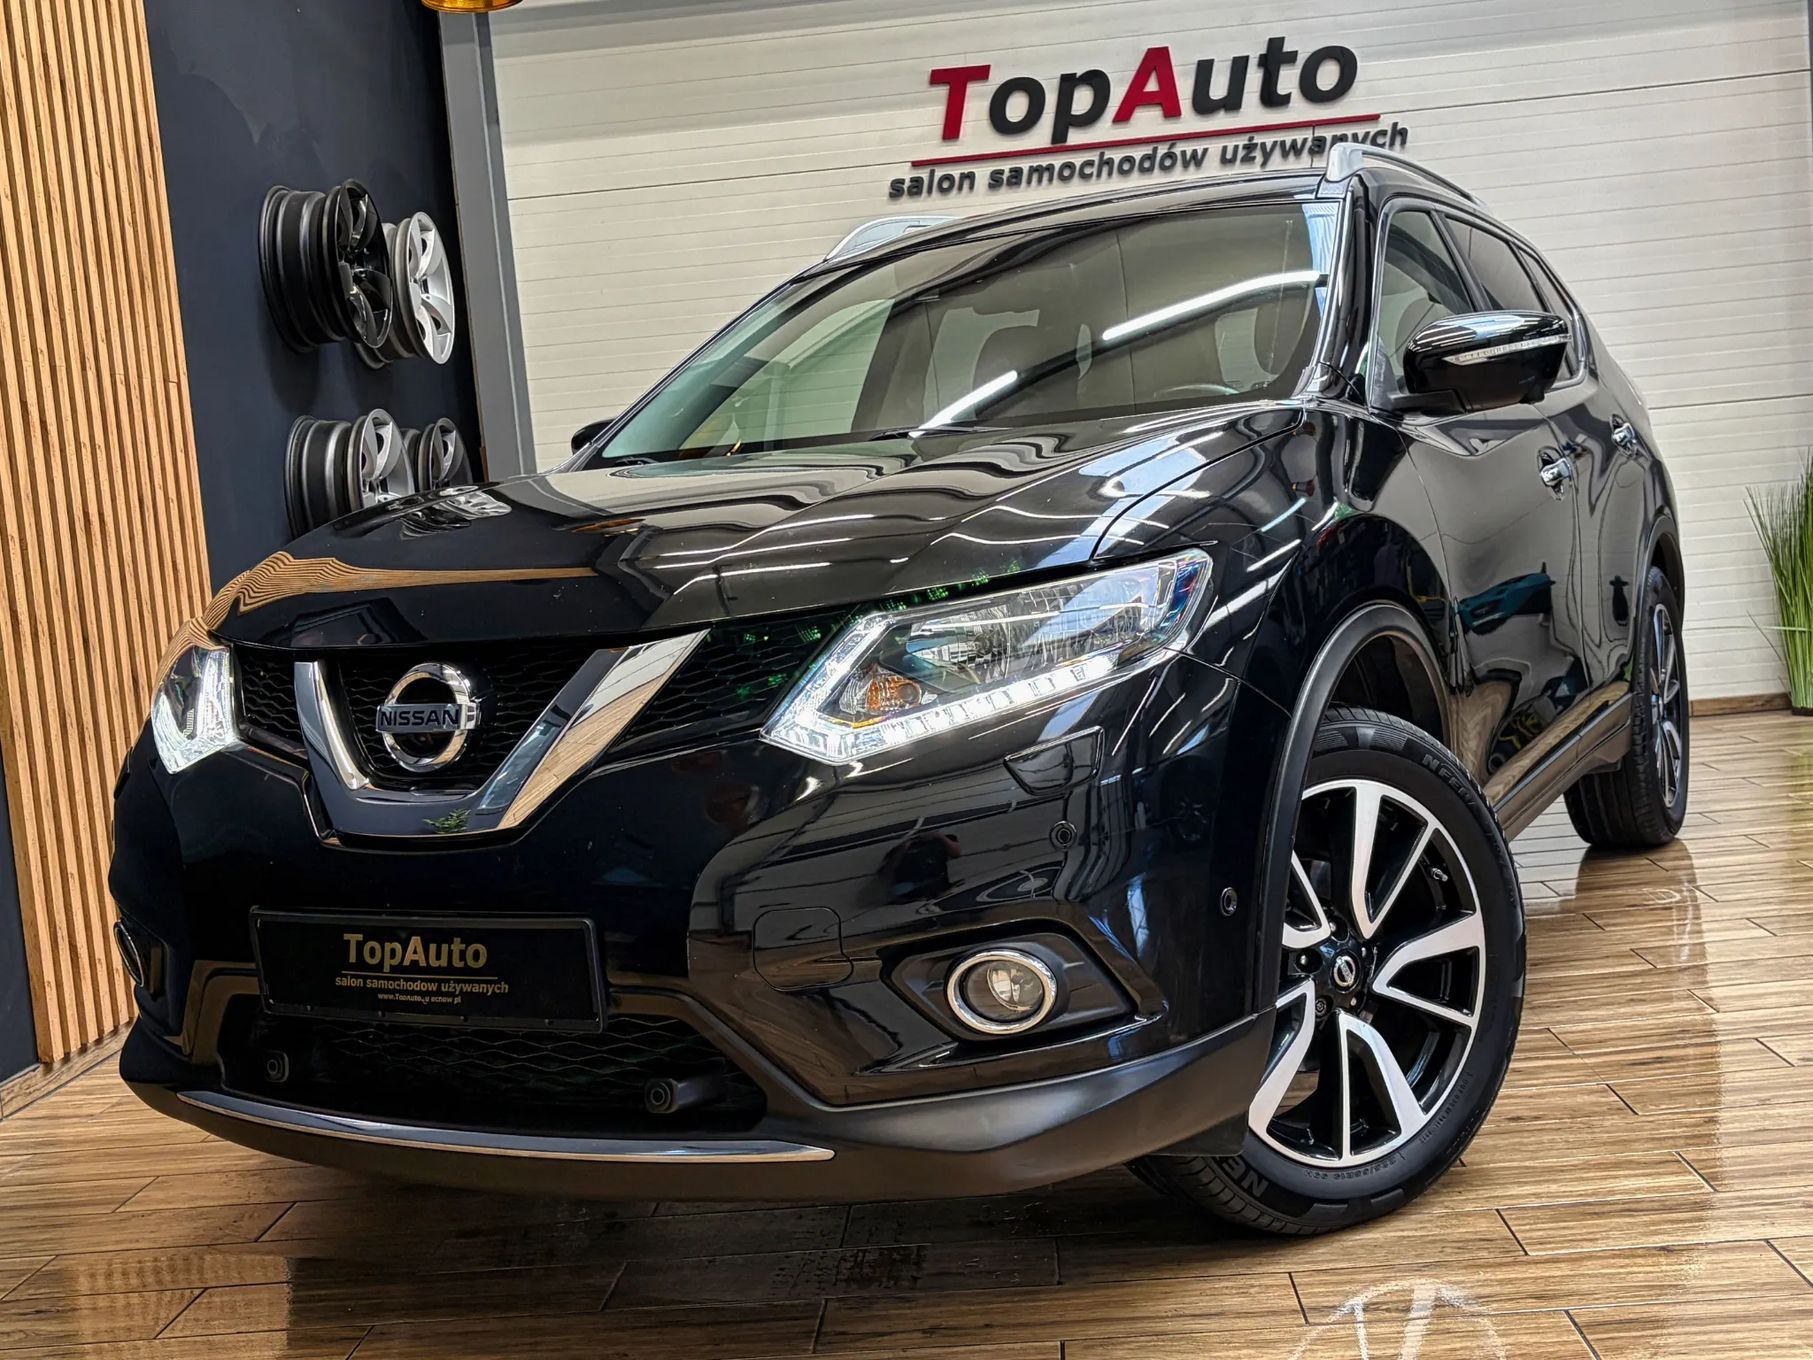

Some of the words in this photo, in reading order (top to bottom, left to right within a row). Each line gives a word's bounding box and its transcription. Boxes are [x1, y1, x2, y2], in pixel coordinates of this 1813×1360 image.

[928, 36, 1358, 145] TopAuto
[889, 168, 976, 198] salon
[988, 142, 1209, 189] samochodów
[380, 709, 460, 726] NISSAN
[343, 933, 488, 973] TopAuto
[335, 976, 364, 987] salon
[441, 980, 509, 996] używanych
